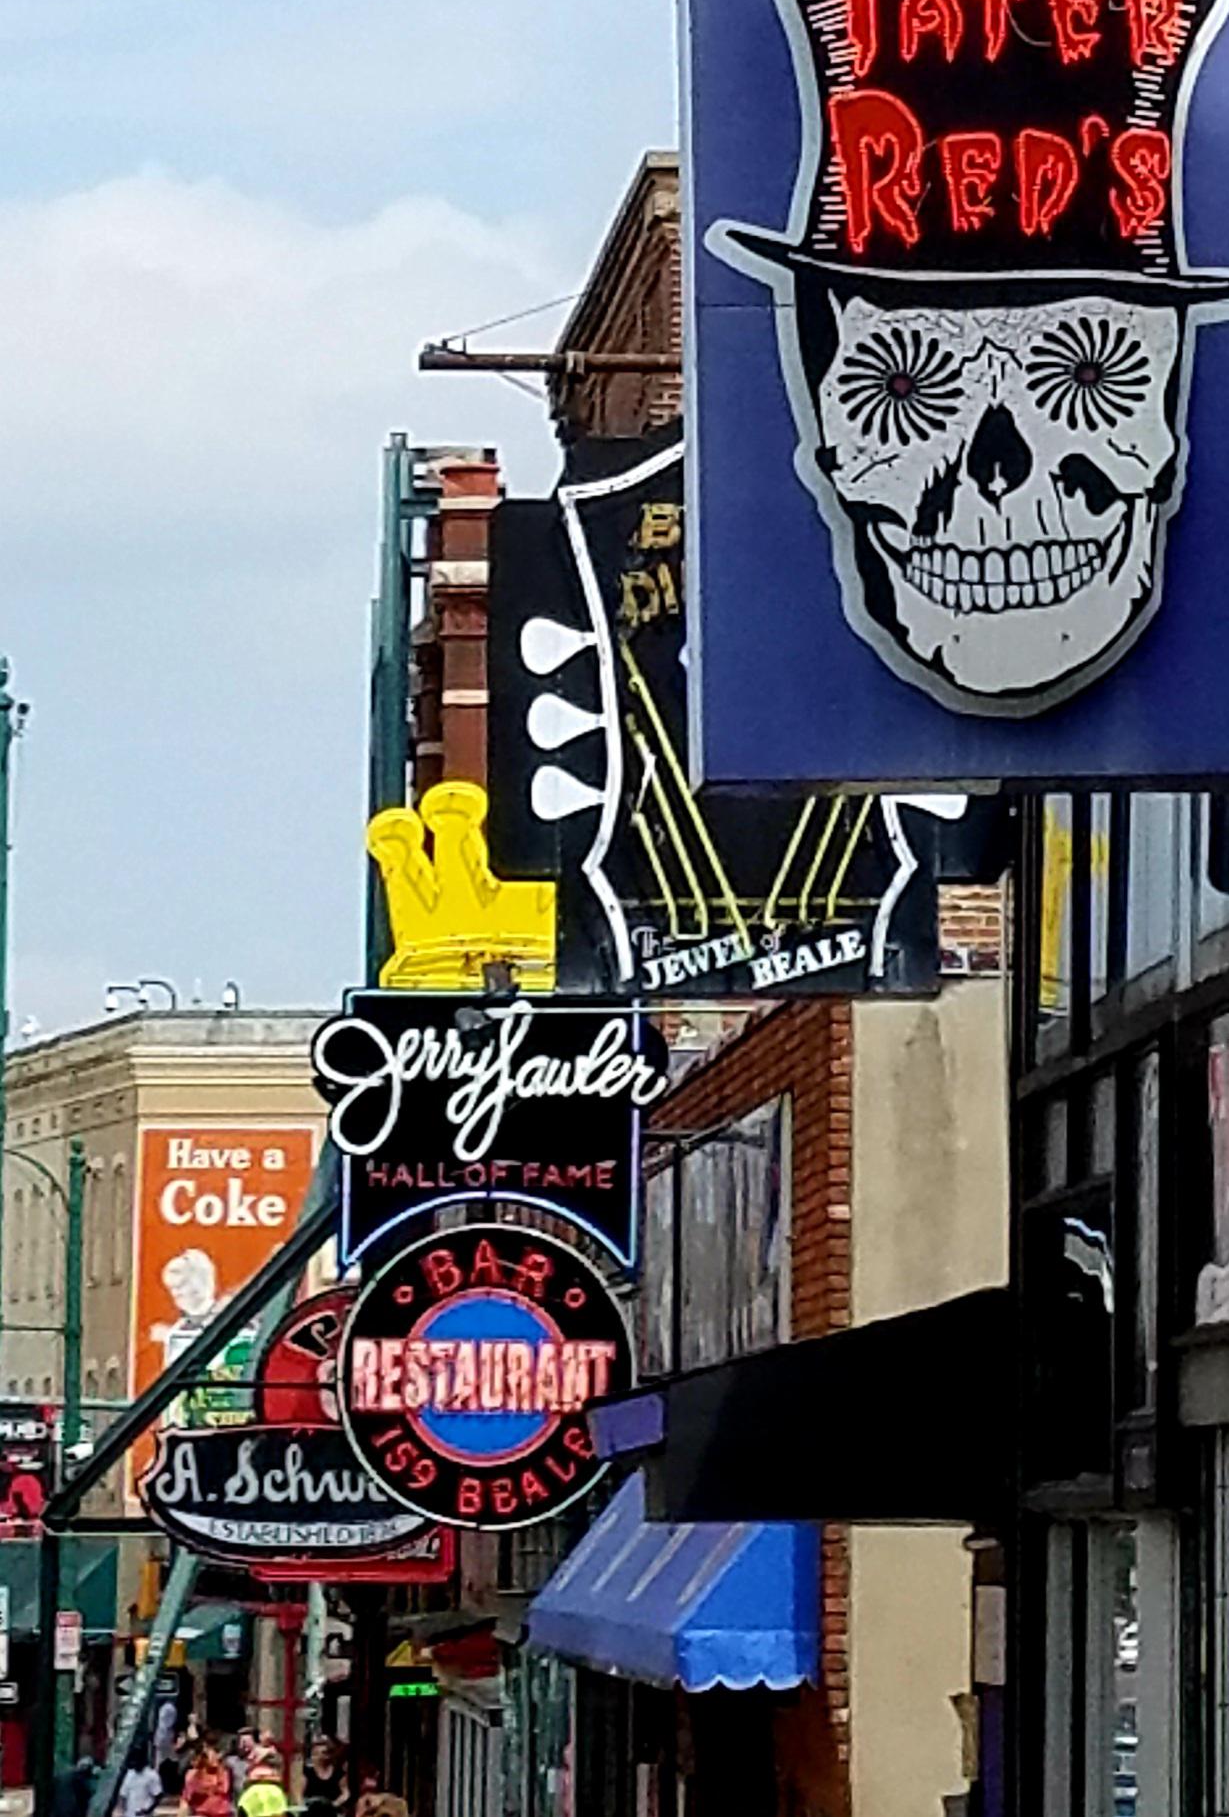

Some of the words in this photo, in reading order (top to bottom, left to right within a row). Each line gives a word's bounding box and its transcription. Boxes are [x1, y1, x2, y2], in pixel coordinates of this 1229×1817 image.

[827, 88, 1173, 253] RED'S
[750, 930, 867, 991] BEALE
[314, 1017, 497, 1156] Jerry
[453, 999, 667, 1162] Lawler
[167, 1138, 252, 1170] Have
[262, 1147, 286, 1170] a
[367, 1160, 455, 1189] HALL
[463, 1160, 508, 1189] OF
[522, 1160, 617, 1190] FAME
[160, 1177, 287, 1228] Coke
[420, 1238, 556, 1298] BAR
[350, 1337, 617, 1414] RESTAURANT
[371, 1426, 439, 1489] 159
